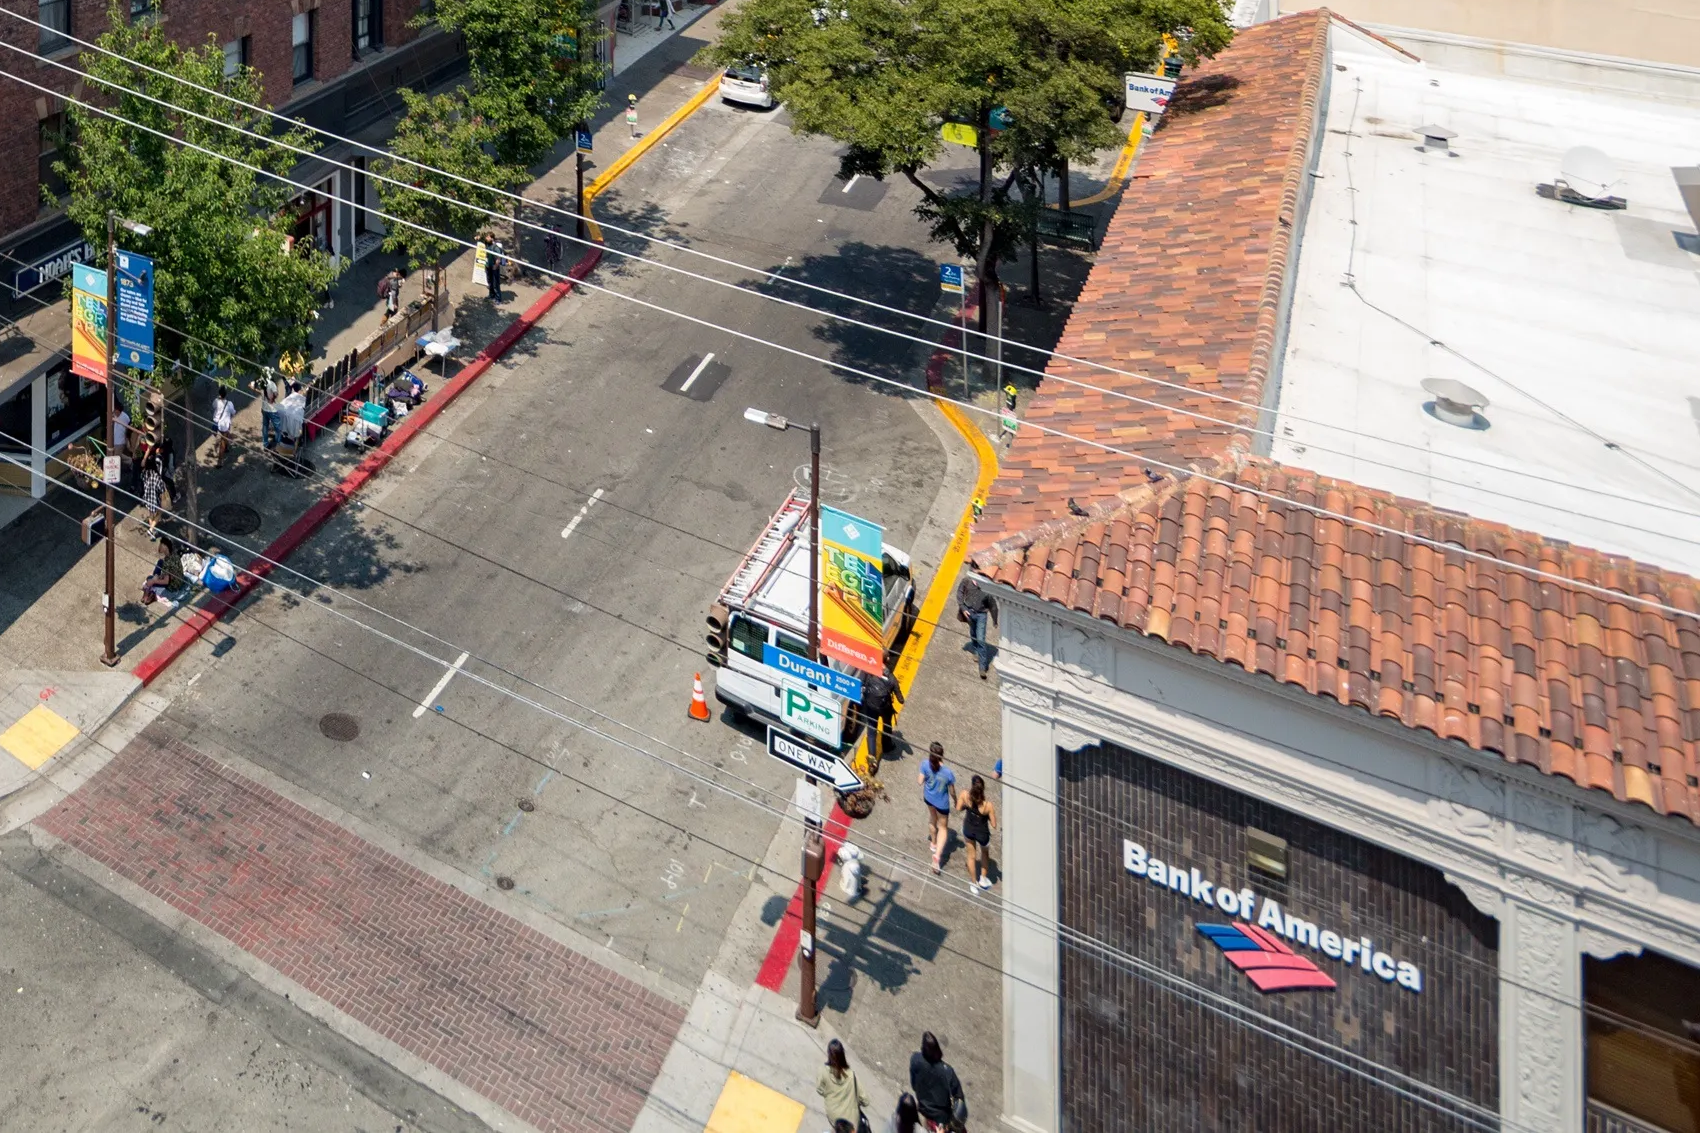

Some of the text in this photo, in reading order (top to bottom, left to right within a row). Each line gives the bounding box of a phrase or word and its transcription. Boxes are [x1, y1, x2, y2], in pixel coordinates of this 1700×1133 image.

[1129, 83, 1149, 94] Bank
[1149, 87, 1158, 95] of
[38, 247, 83, 284] NOAH'S
[823, 544, 878, 579] TEL
[825, 563, 876, 595] EGR
[823, 581, 878, 613] APH
[778, 653, 832, 686] Durant
[786, 688, 812, 717] P
[778, 741, 834, 774] ONE WAY
[1123, 838, 1423, 992] Bank of America
